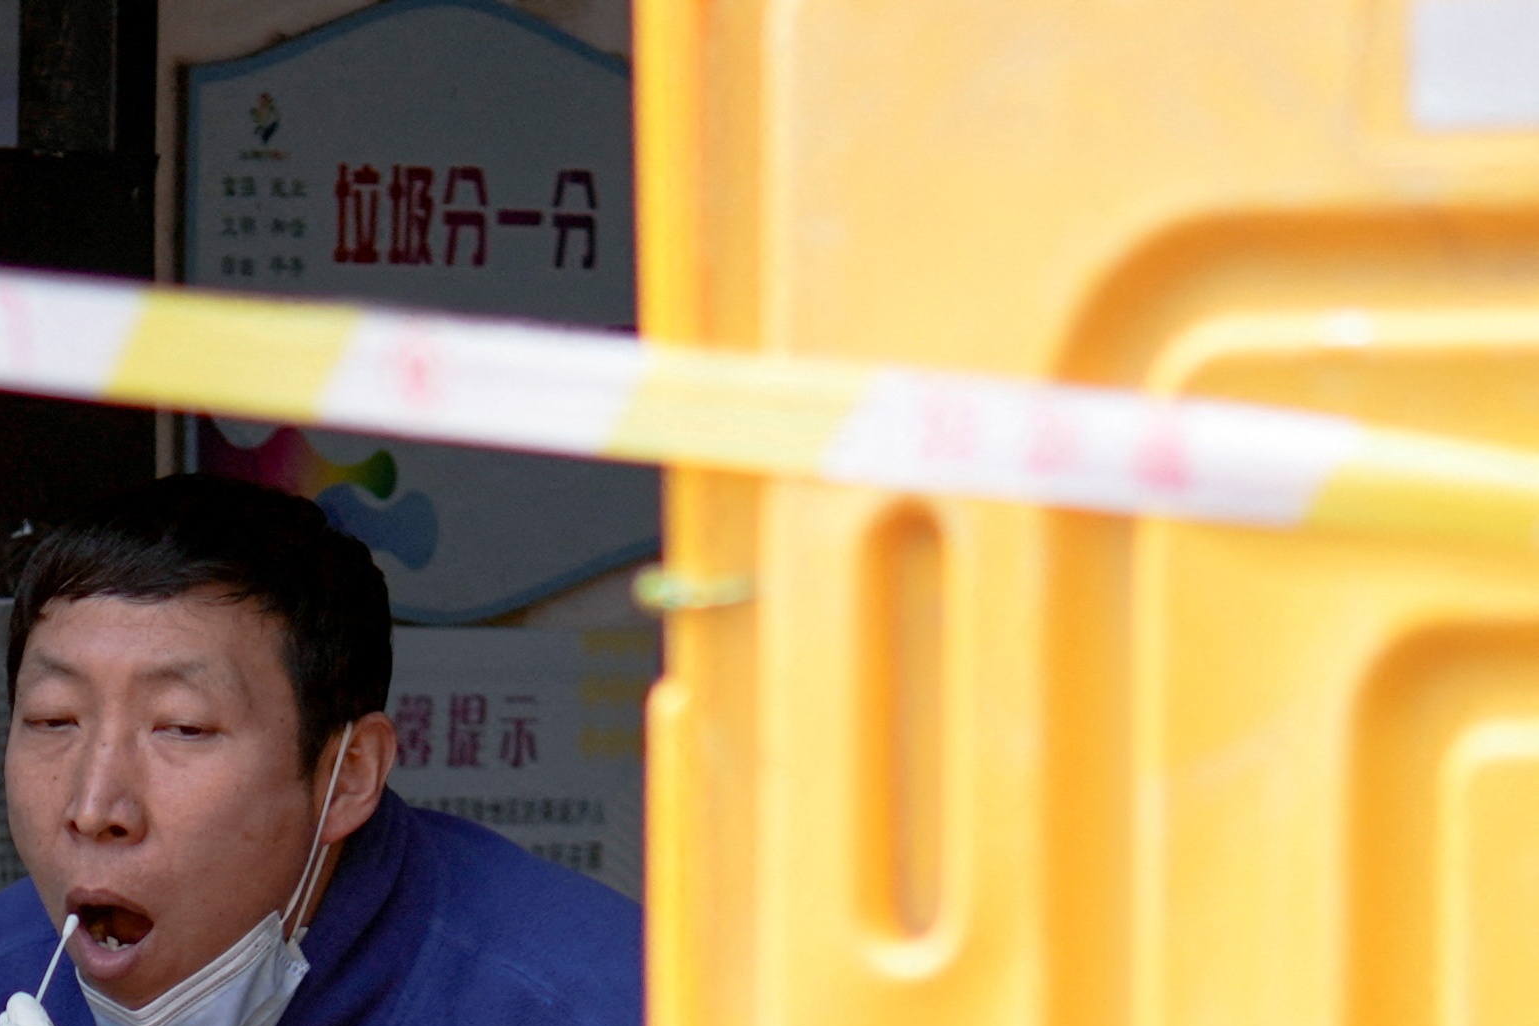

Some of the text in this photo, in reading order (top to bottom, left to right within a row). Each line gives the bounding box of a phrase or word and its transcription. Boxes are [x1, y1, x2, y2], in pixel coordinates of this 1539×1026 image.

[333, 161, 599, 269] 垃圾分一分
